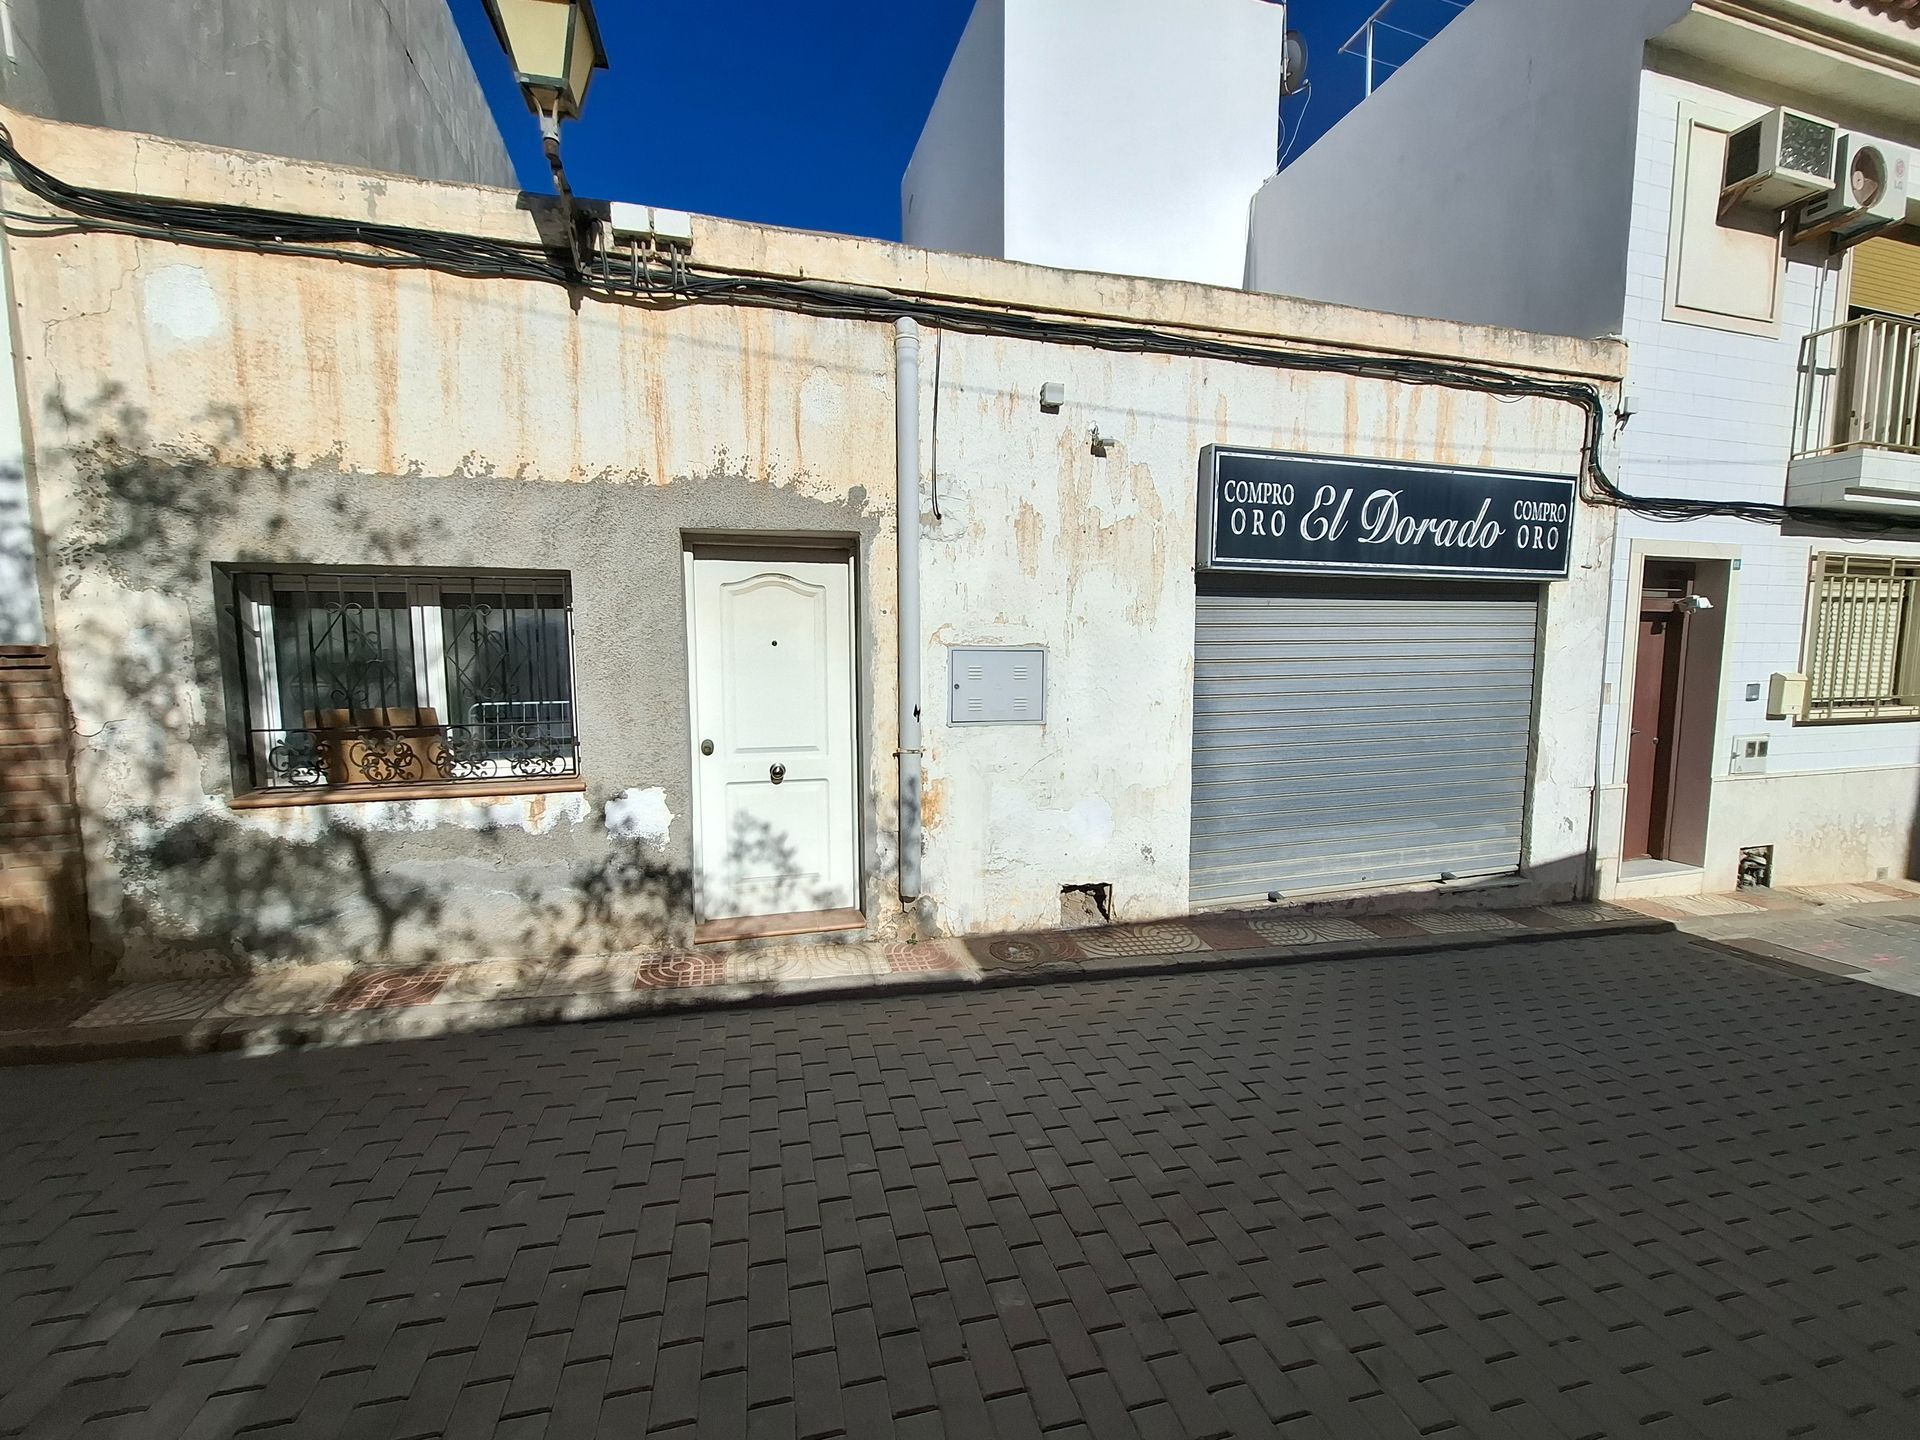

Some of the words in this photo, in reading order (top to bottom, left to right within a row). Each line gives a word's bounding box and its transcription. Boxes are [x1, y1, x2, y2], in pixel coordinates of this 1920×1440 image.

[1224, 480, 1294, 505] COMPRO
[1231, 508, 1285, 536] ORO
[1300, 485, 1354, 541] El
[1358, 489, 1506, 548] Dorado
[1514, 500, 1566, 522] COMPRO
[1517, 525, 1559, 550] ORO
